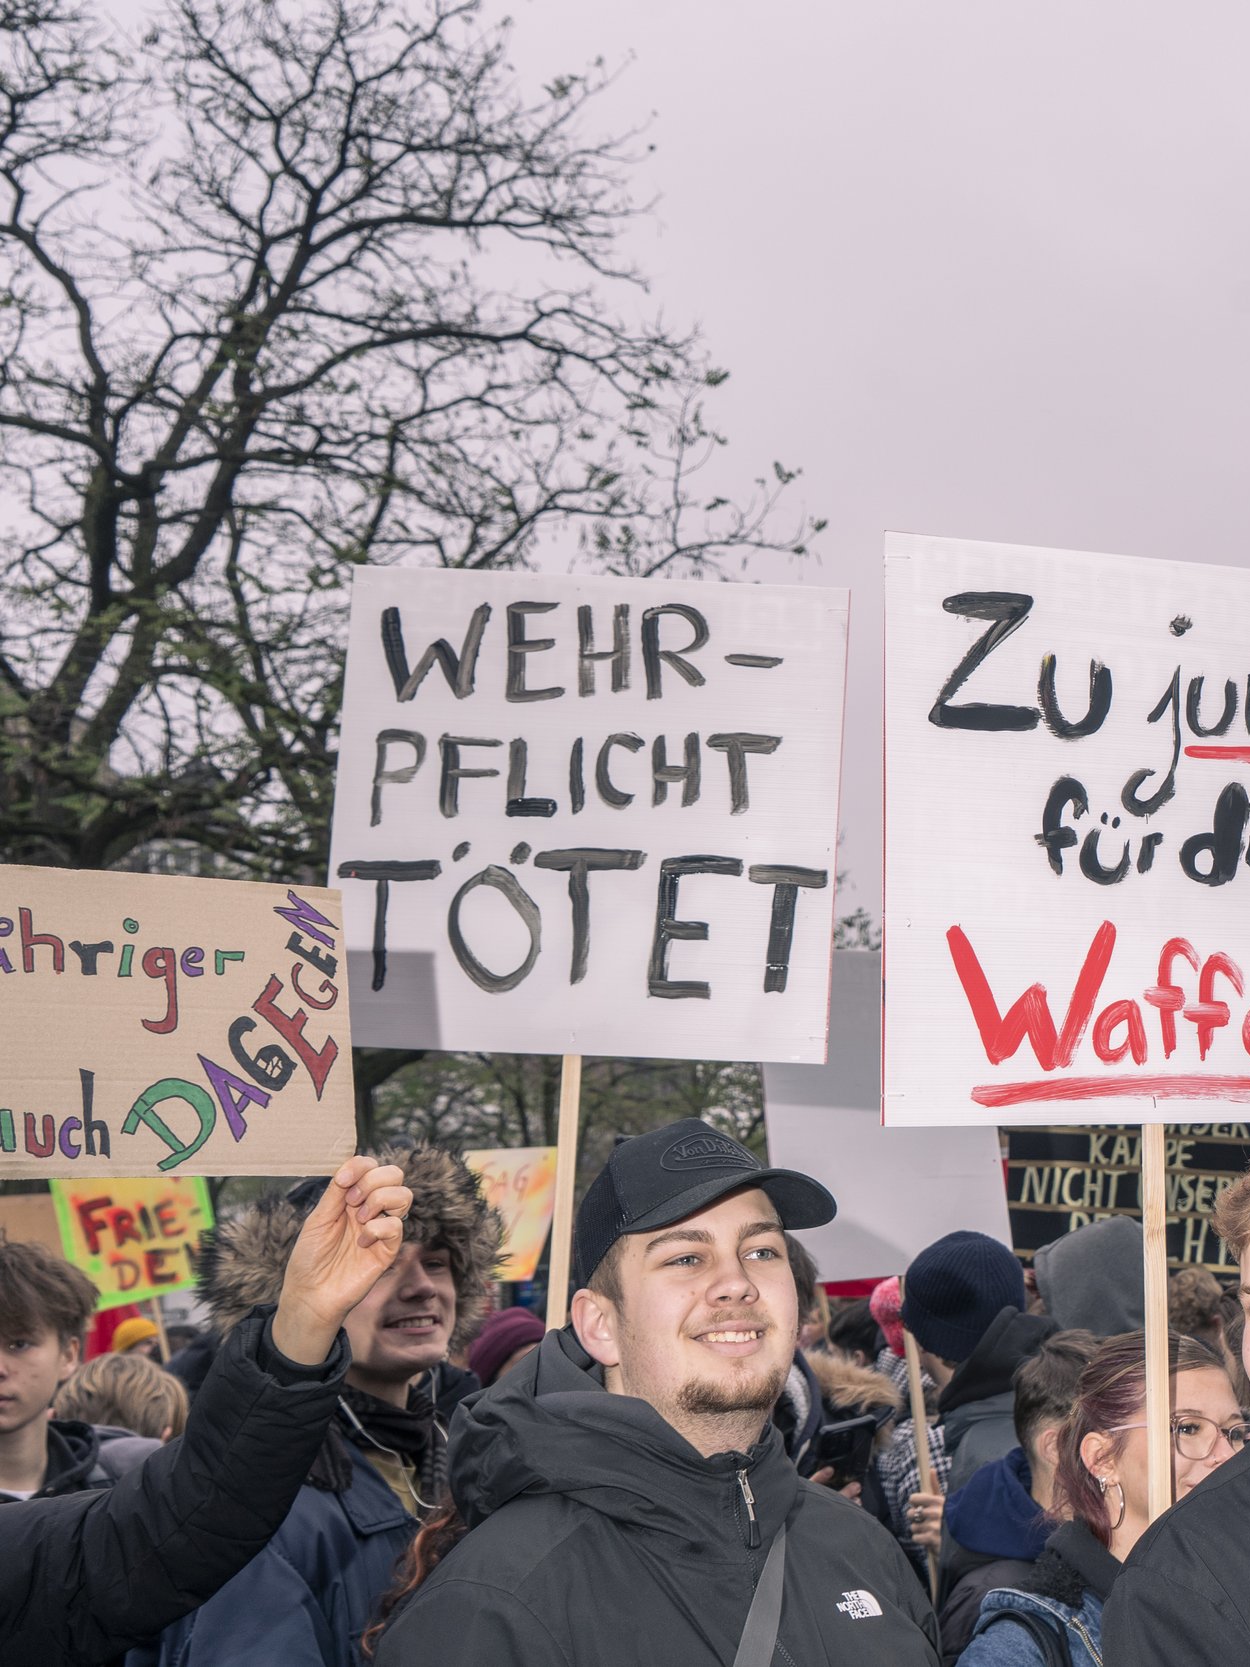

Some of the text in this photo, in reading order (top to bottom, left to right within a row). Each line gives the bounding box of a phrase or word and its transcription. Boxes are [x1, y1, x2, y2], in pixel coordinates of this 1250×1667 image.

[381, 601, 784, 703] WEHR-
[928, 591, 1113, 740] Zu
[370, 728, 783, 827] PFLICHT
[1035, 775, 1164, 886] für
[337, 841, 829, 1000] TÖTET
[122, 889, 340, 1171] DAGEGEN
[76, 1195, 202, 1256] FRIE-
[1020, 1166, 1128, 1208] NICHT
[836, 1601, 866, 1612] NORTH
[842, 1591, 861, 1601] THE
[850, 1609, 870, 1620] FACE
